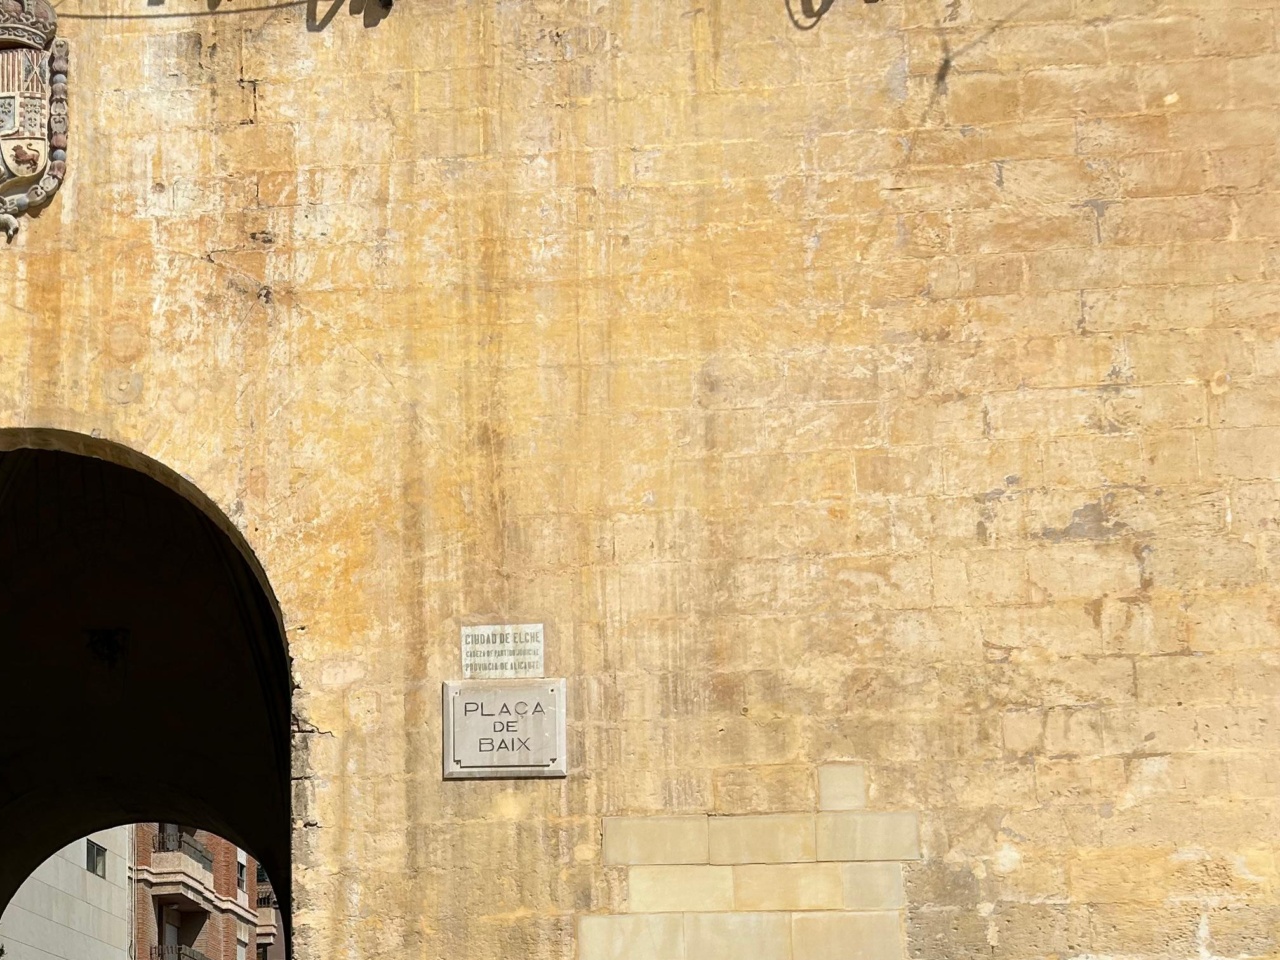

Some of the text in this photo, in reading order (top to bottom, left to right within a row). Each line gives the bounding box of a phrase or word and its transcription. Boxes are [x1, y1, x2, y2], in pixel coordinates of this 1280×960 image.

[465, 632, 541, 645] CIUDAD DE ELCHE
[465, 661, 540, 672] PROVINCIA DE ALICANTE
[464, 701, 546, 719] PLAÇA
[493, 721, 518, 732] DE
[478, 737, 531, 752] BAIX
